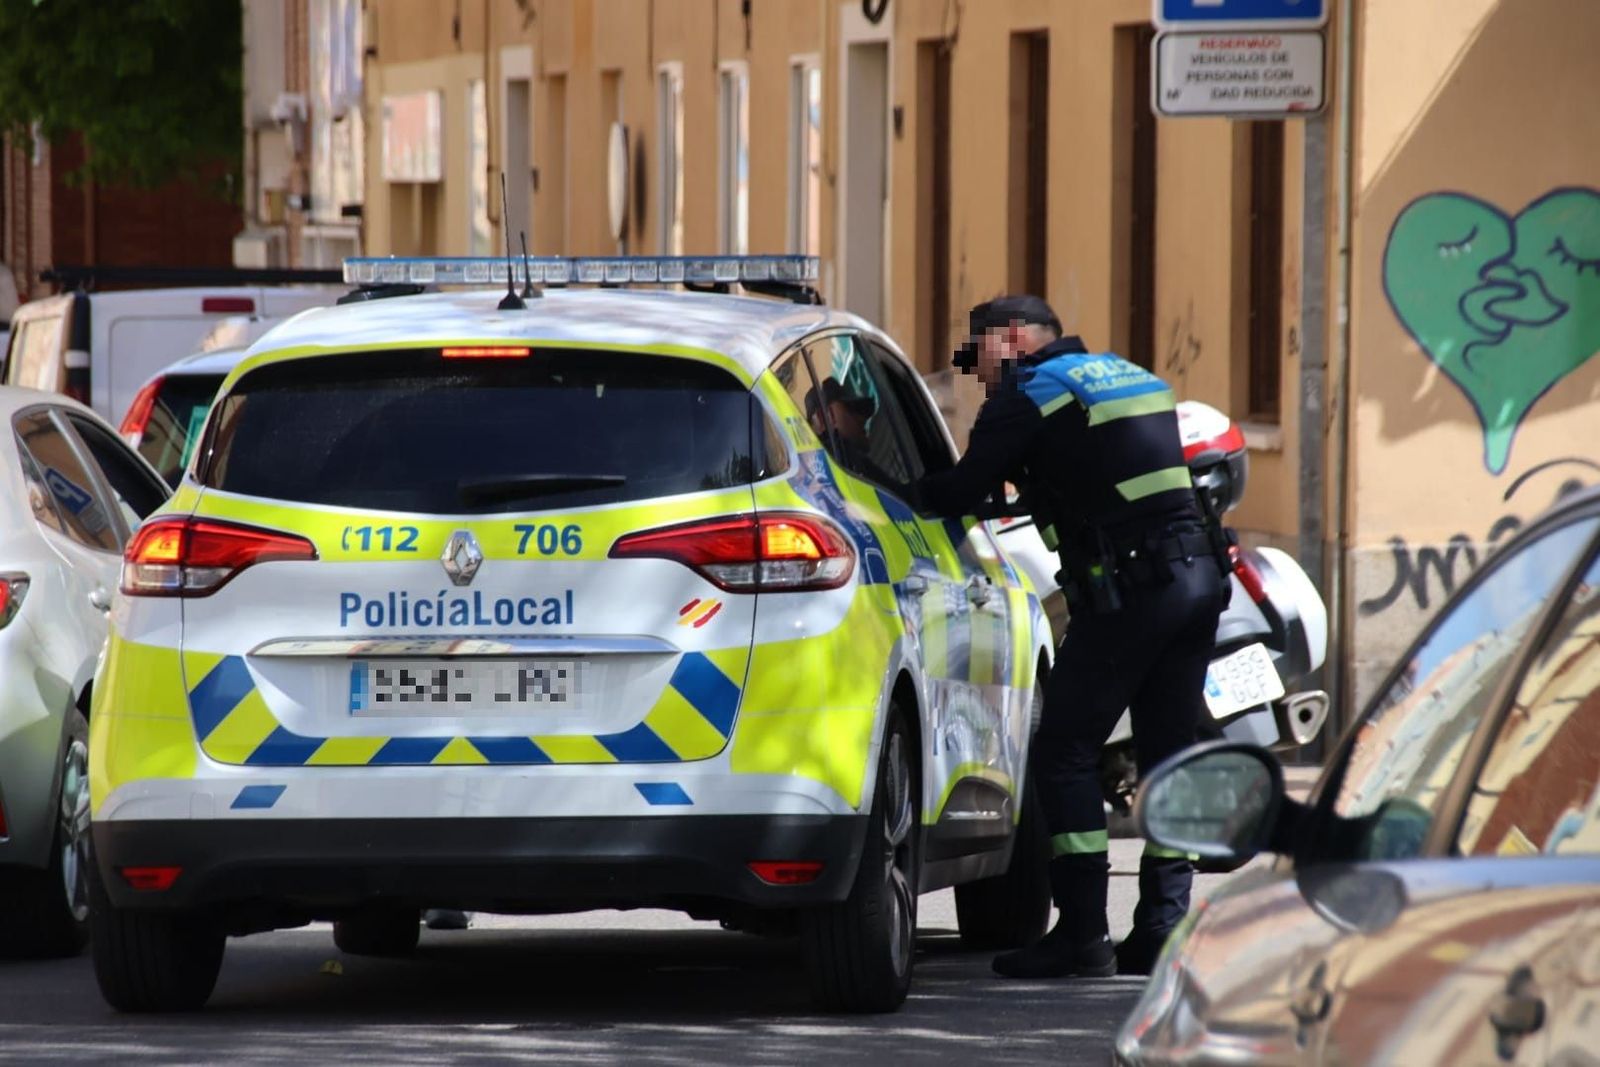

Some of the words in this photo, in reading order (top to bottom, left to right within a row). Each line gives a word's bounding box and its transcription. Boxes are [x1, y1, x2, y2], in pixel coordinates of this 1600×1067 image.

[1199, 37, 1282, 49] RESERVADO
[1271, 52, 1288, 63] DE
[1186, 70, 1260, 82] PERSONAS
[1263, 69, 1295, 81] CON
[1243, 86, 1315, 99] REDUCIDA
[355, 526, 419, 551] 112
[514, 524, 583, 555] 706
